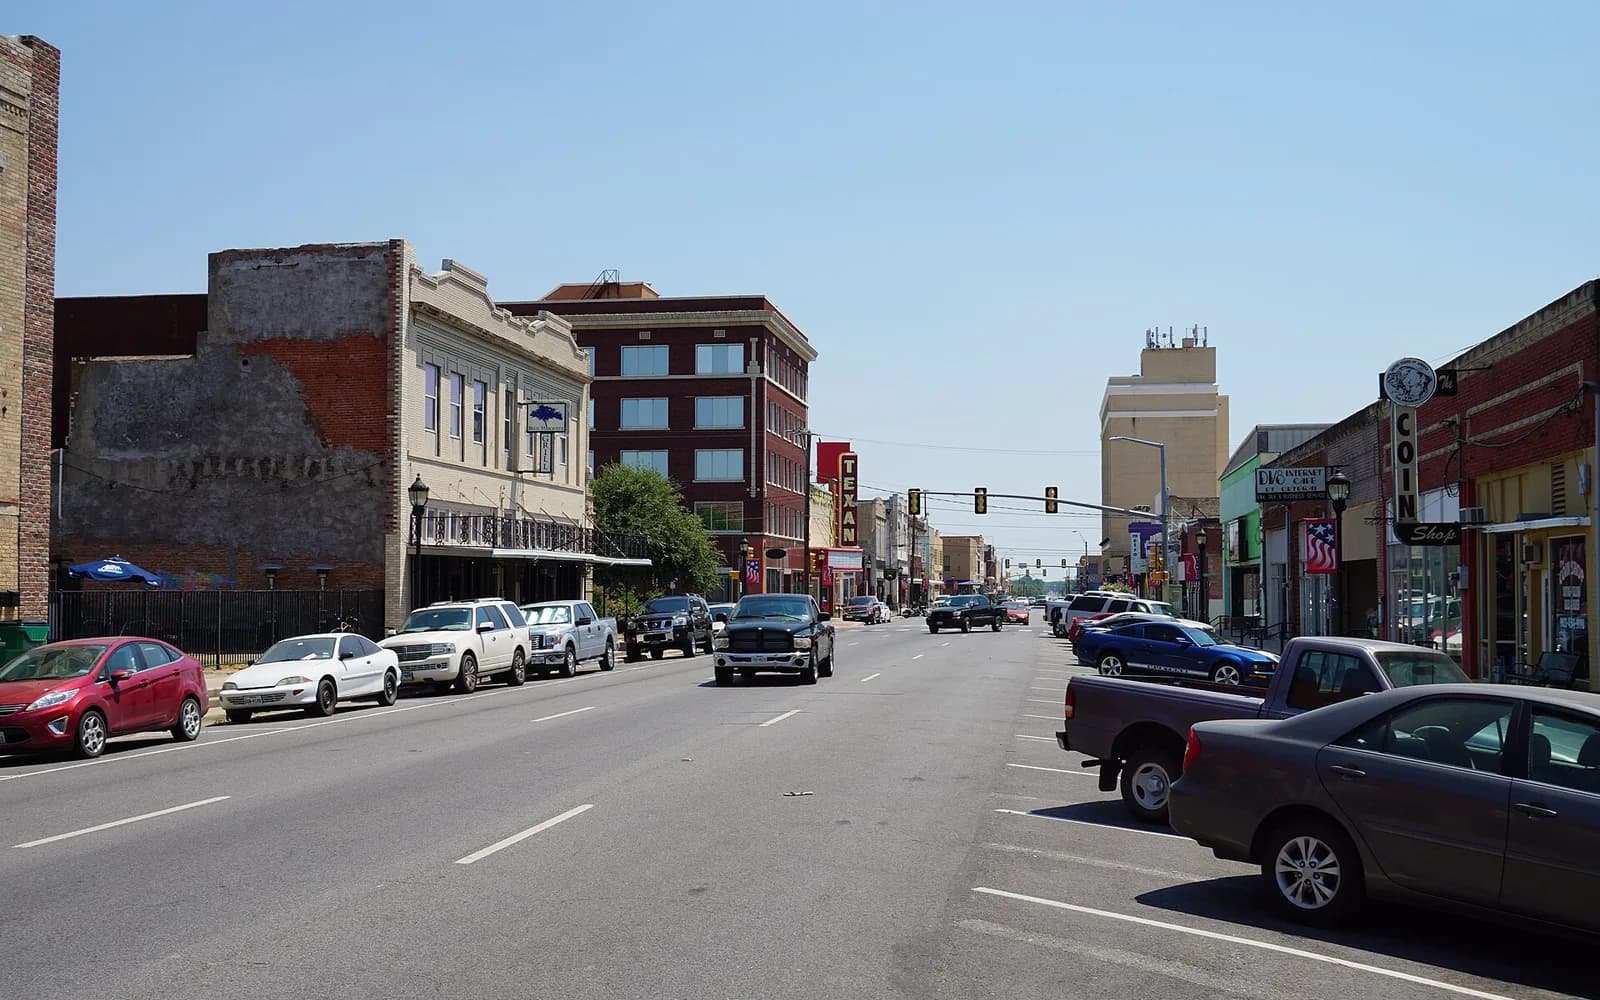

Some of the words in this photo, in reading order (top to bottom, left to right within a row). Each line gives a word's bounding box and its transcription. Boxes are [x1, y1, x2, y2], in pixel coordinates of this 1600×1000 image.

[1439, 375, 1454, 390] The
[1397, 412, 1414, 518] COIN
[1259, 470, 1286, 485] DV8
[843, 459, 855, 542] TEXAN
[1411, 525, 1457, 543] Shop
